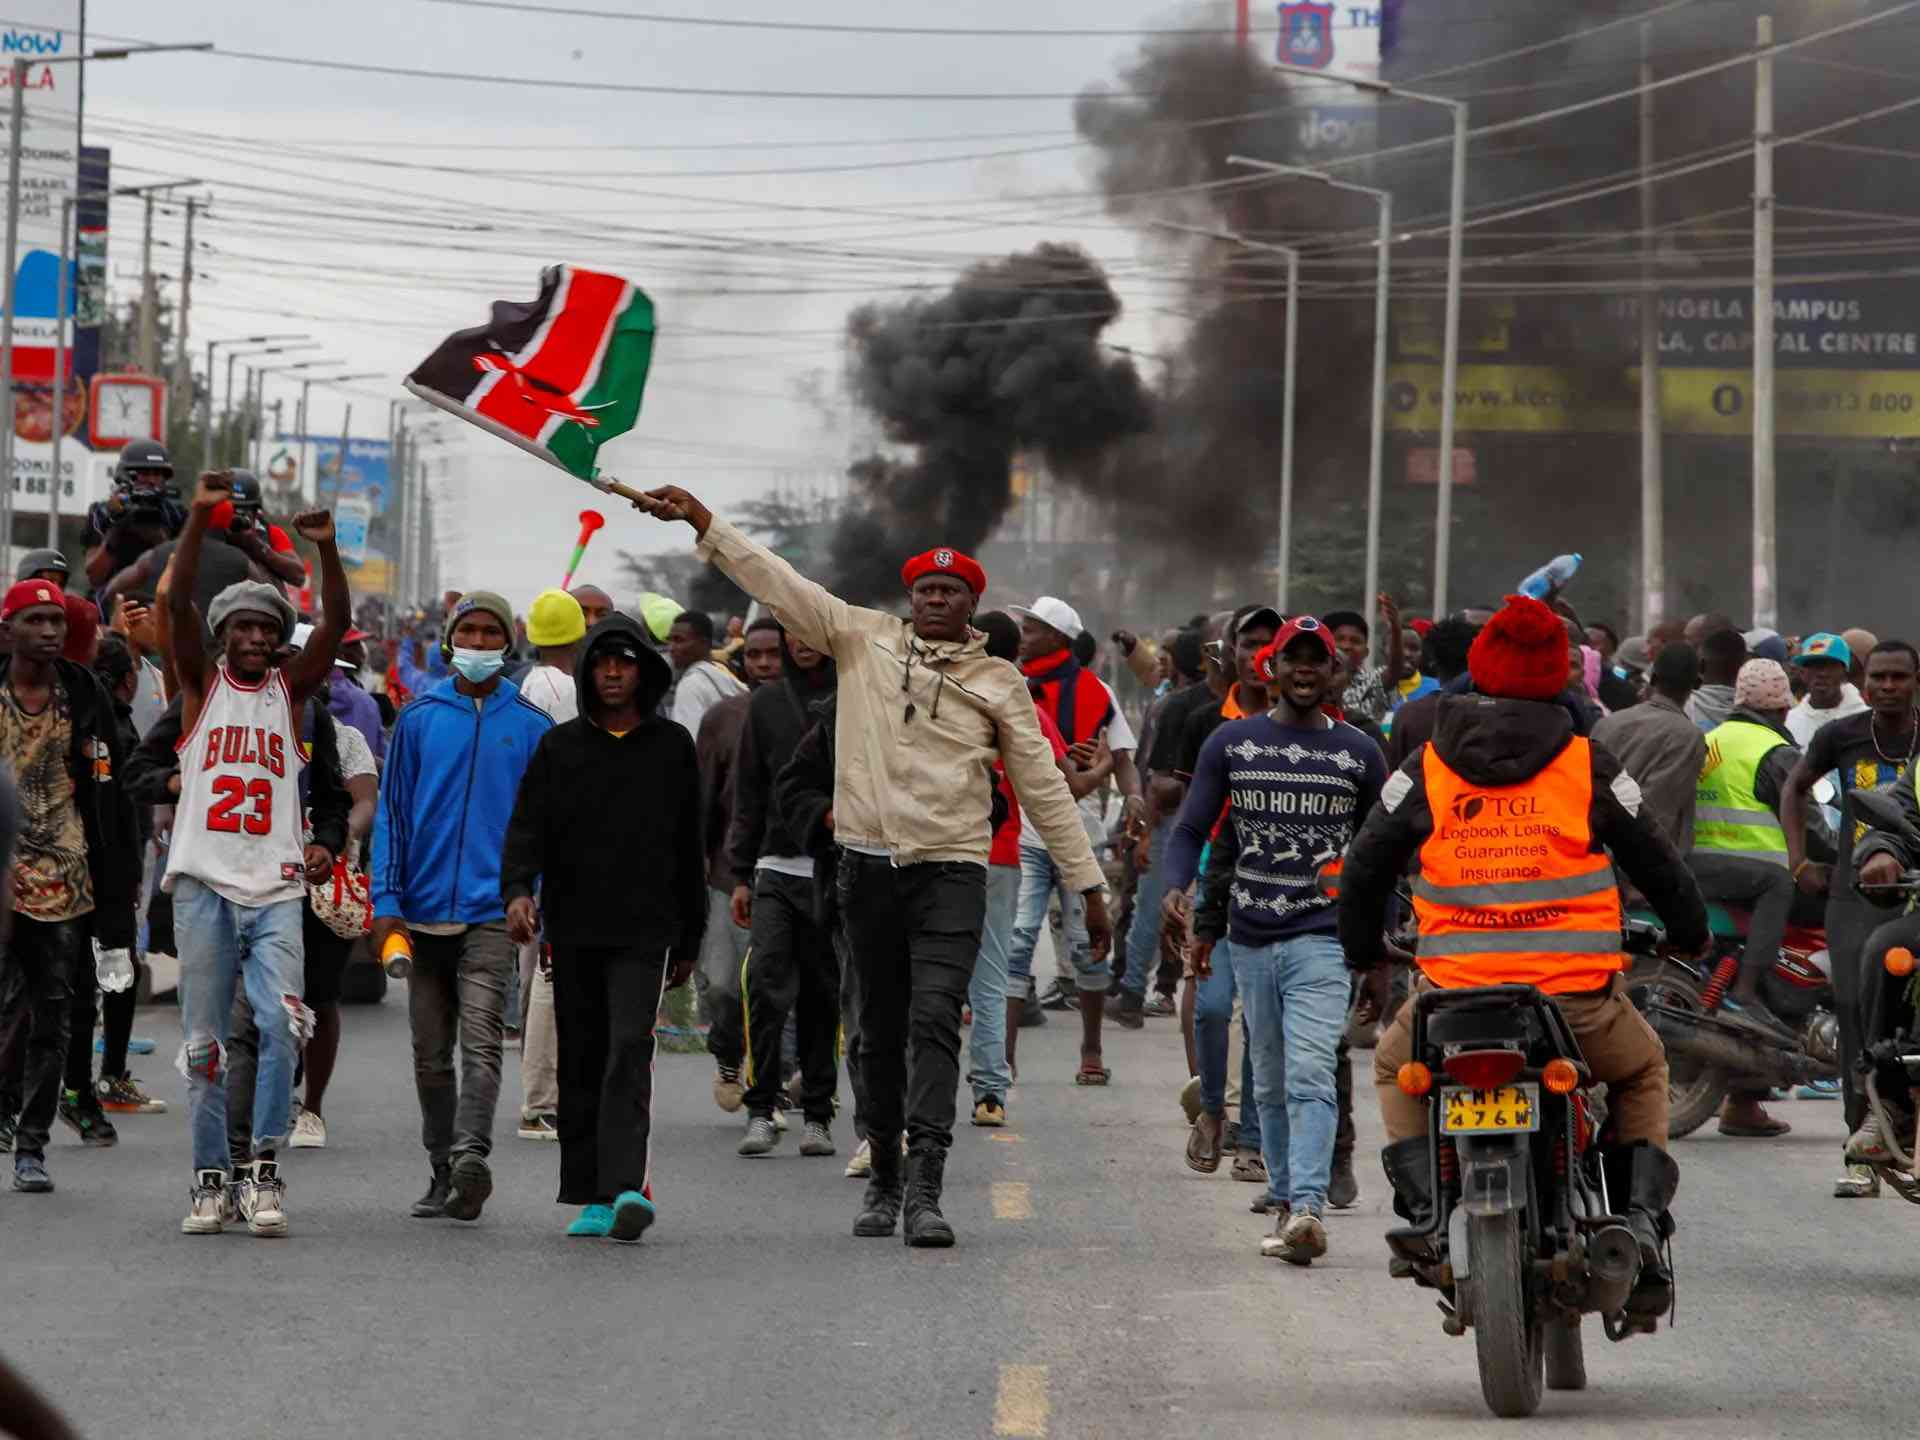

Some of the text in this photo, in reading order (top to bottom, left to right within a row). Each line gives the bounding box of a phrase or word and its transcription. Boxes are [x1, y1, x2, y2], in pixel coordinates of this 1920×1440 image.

[2, 30, 62, 53] NOW
[1768, 298, 1861, 321] AMPUS
[1819, 331, 1916, 353] CENTRE
[202, 725, 285, 778] BULLS
[207, 775, 272, 835] 23
[1270, 791, 1296, 814] HO
[1300, 792, 1327, 815] HO
[1490, 796, 1545, 817] TGL
[1440, 824, 1561, 842] Logbook Loans
[1454, 843, 1549, 860] Guarantees
[1460, 864, 1542, 881] Insurance
[1452, 1110, 1528, 1126] 476W
